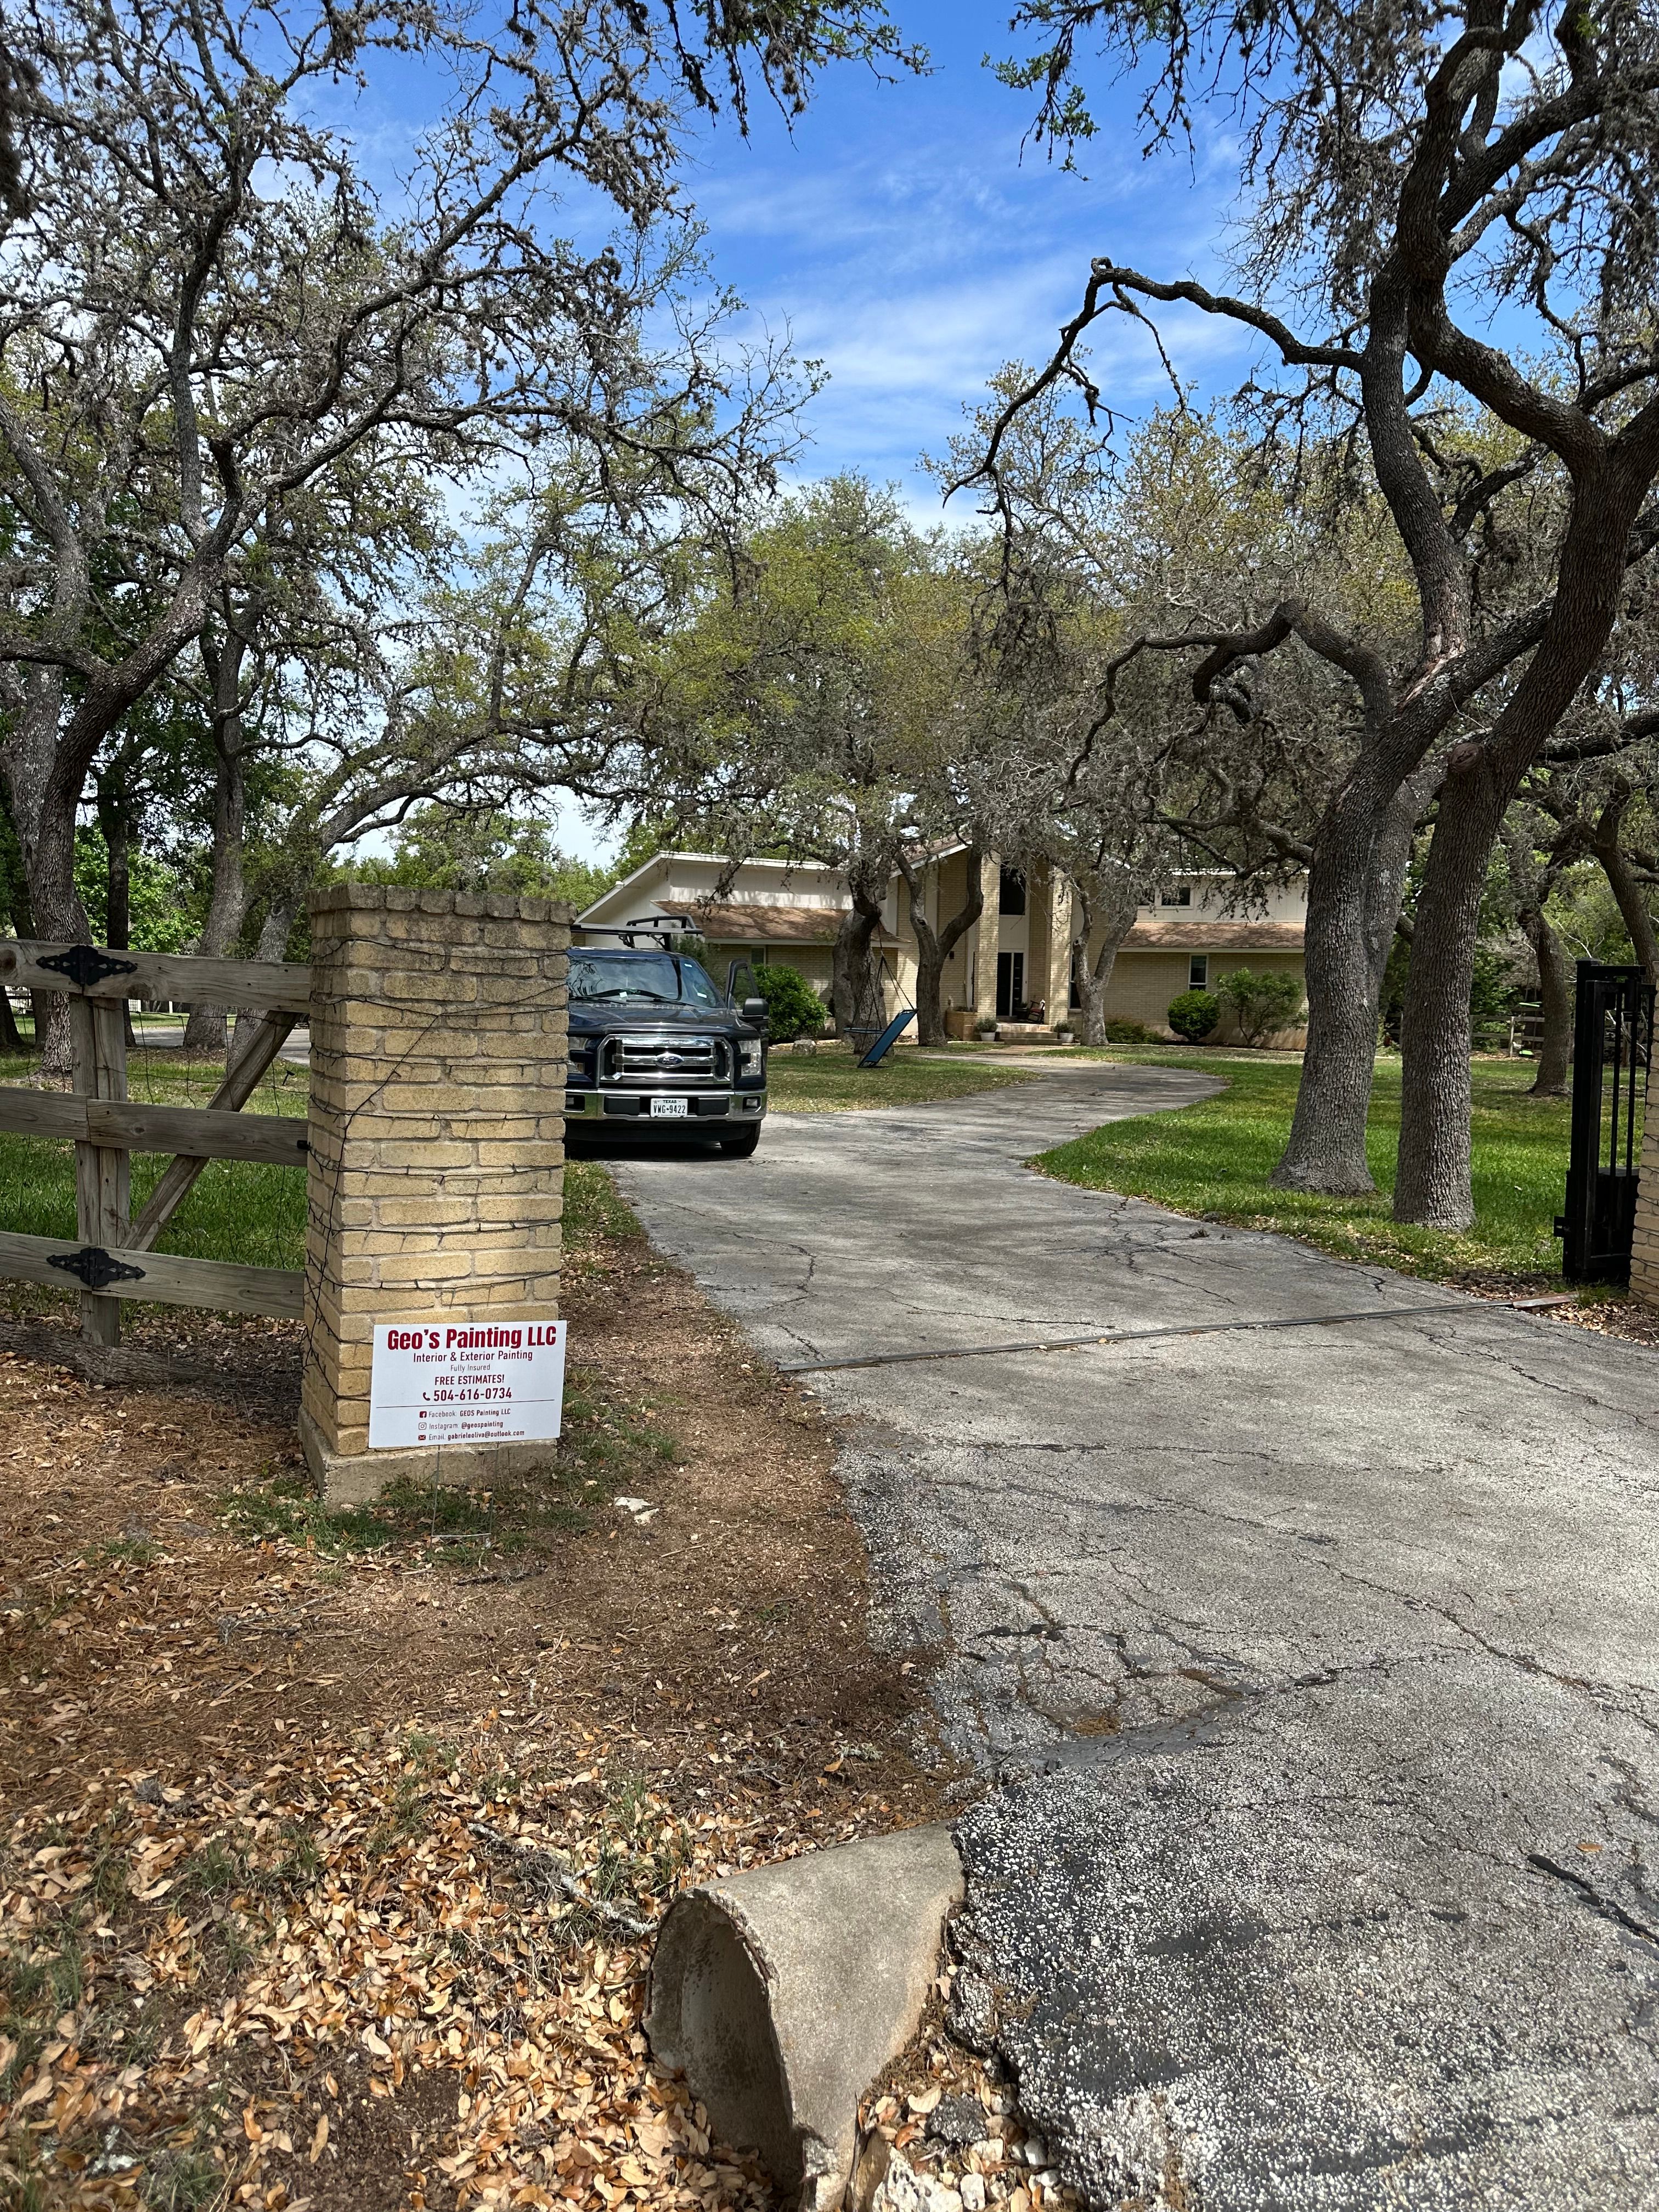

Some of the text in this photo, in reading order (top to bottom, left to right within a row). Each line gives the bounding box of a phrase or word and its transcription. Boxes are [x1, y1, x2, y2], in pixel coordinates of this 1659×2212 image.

[387, 1325, 556, 1350] Geo's Painting LLC
[413, 1350, 533, 1362] Interior & Exterior Painting
[450, 1364, 465, 1373] Fully
[435, 1374, 505, 1385] FREE ESTIMATES!
[433, 1387, 512, 1401] 504-616-0734
[461, 1421, 503, 1429] @geospainting
